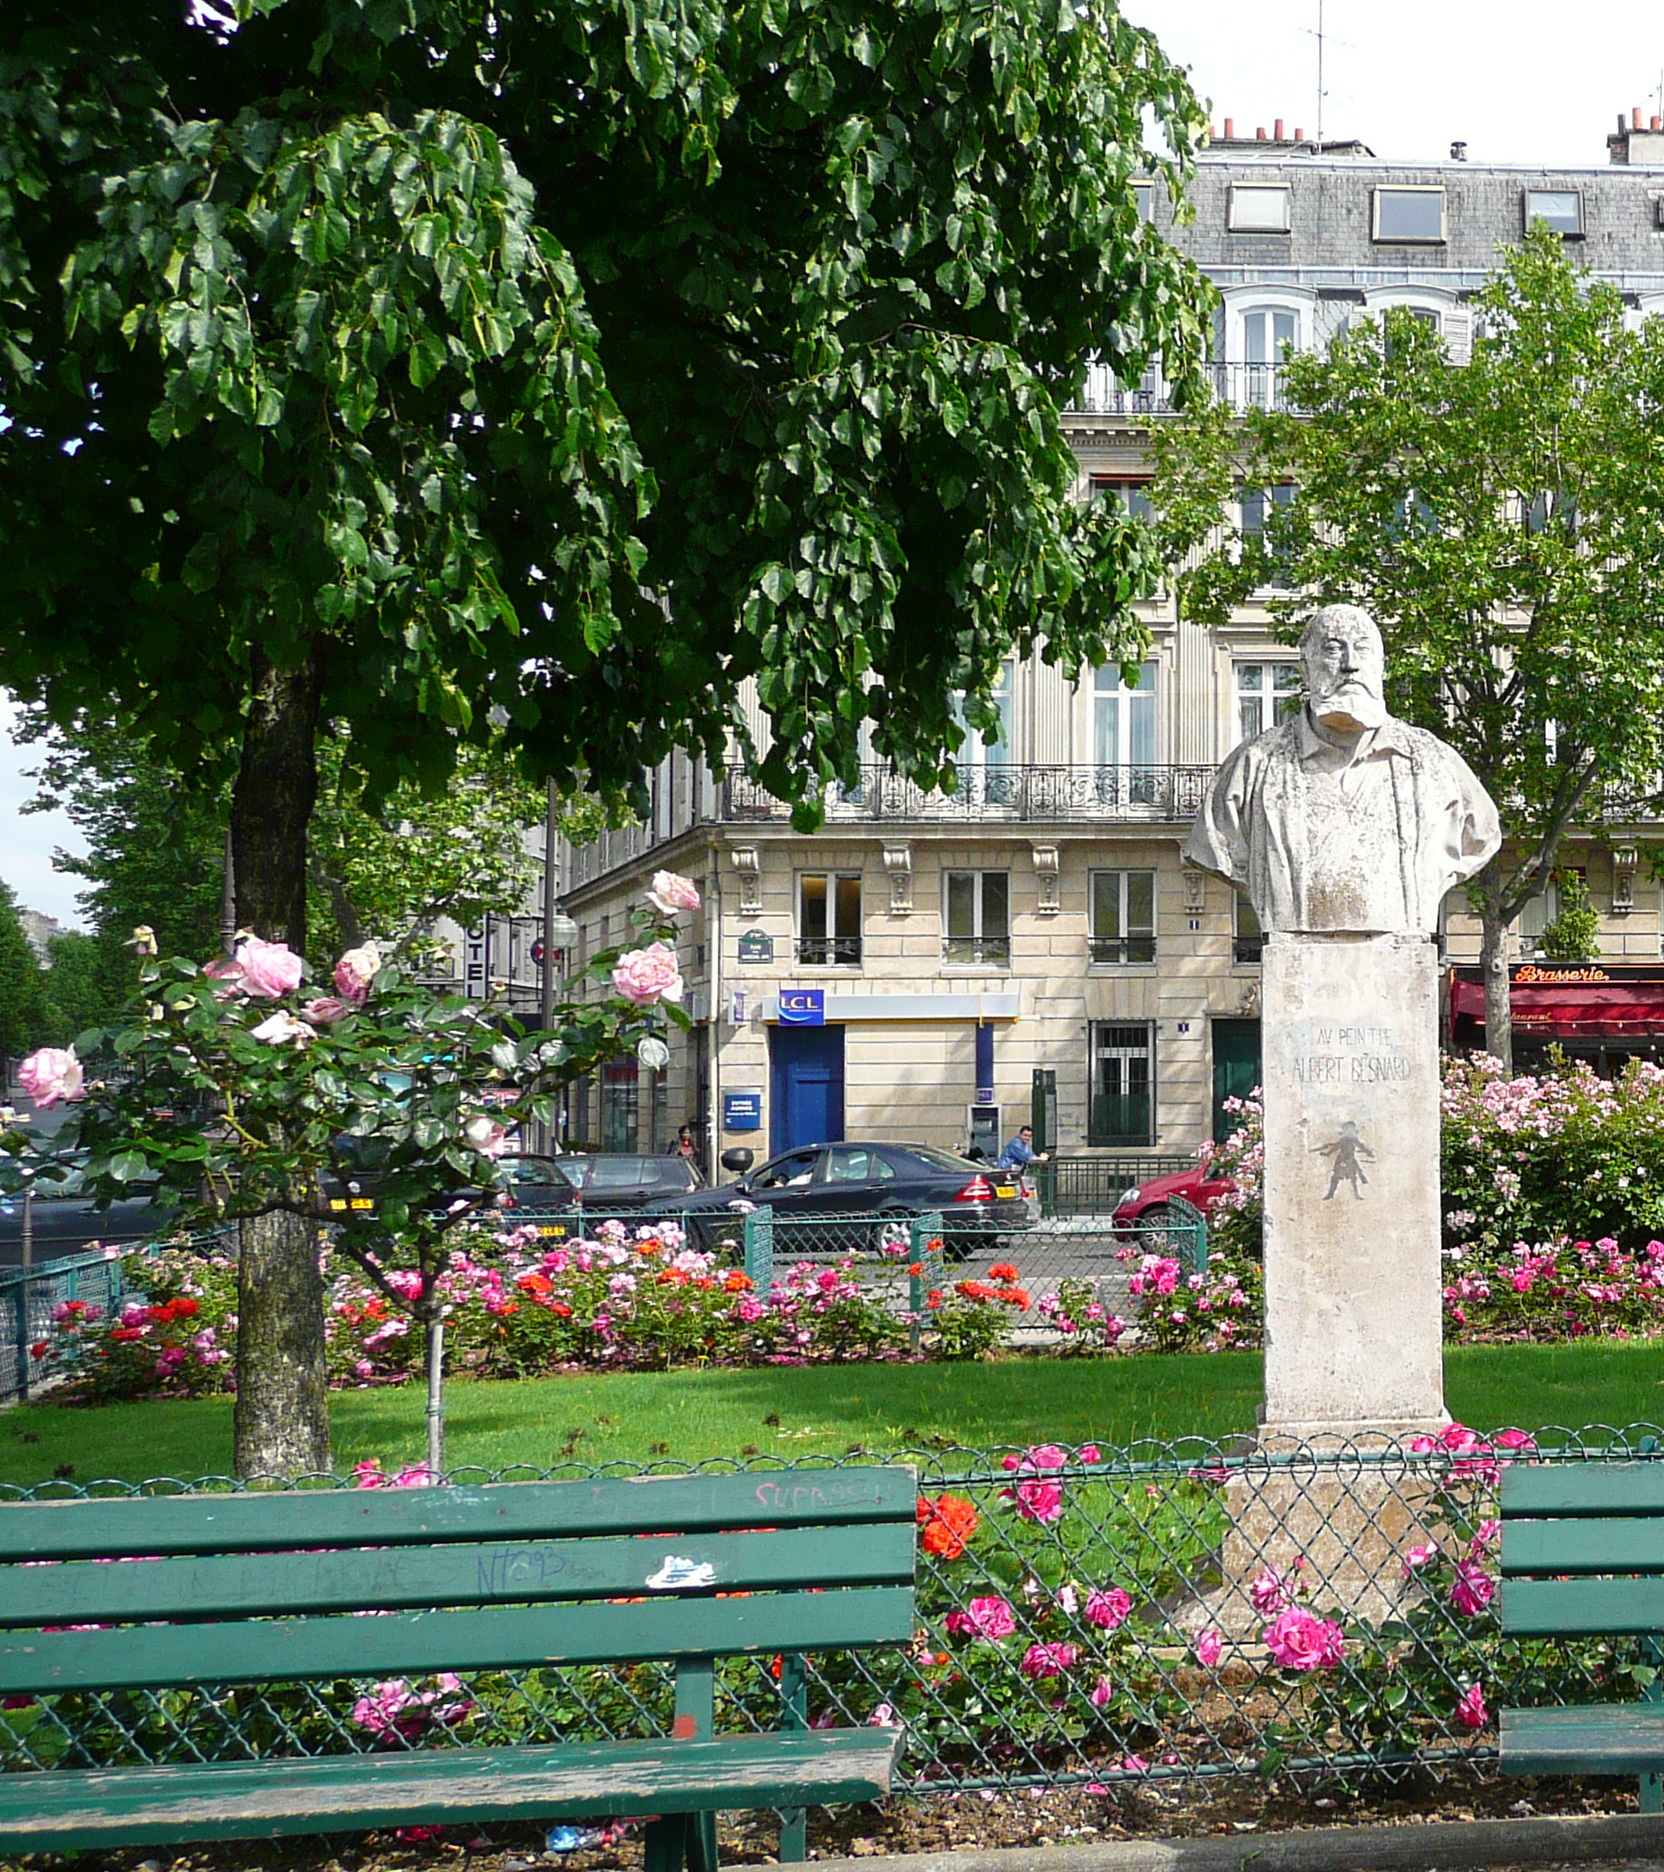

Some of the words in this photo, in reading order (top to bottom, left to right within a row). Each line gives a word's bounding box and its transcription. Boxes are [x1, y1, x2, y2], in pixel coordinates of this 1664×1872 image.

[466, 926, 484, 1000] OTEL
[780, 996, 819, 1009] LCL
[1292, 1056, 1344, 1084] ALBERT
